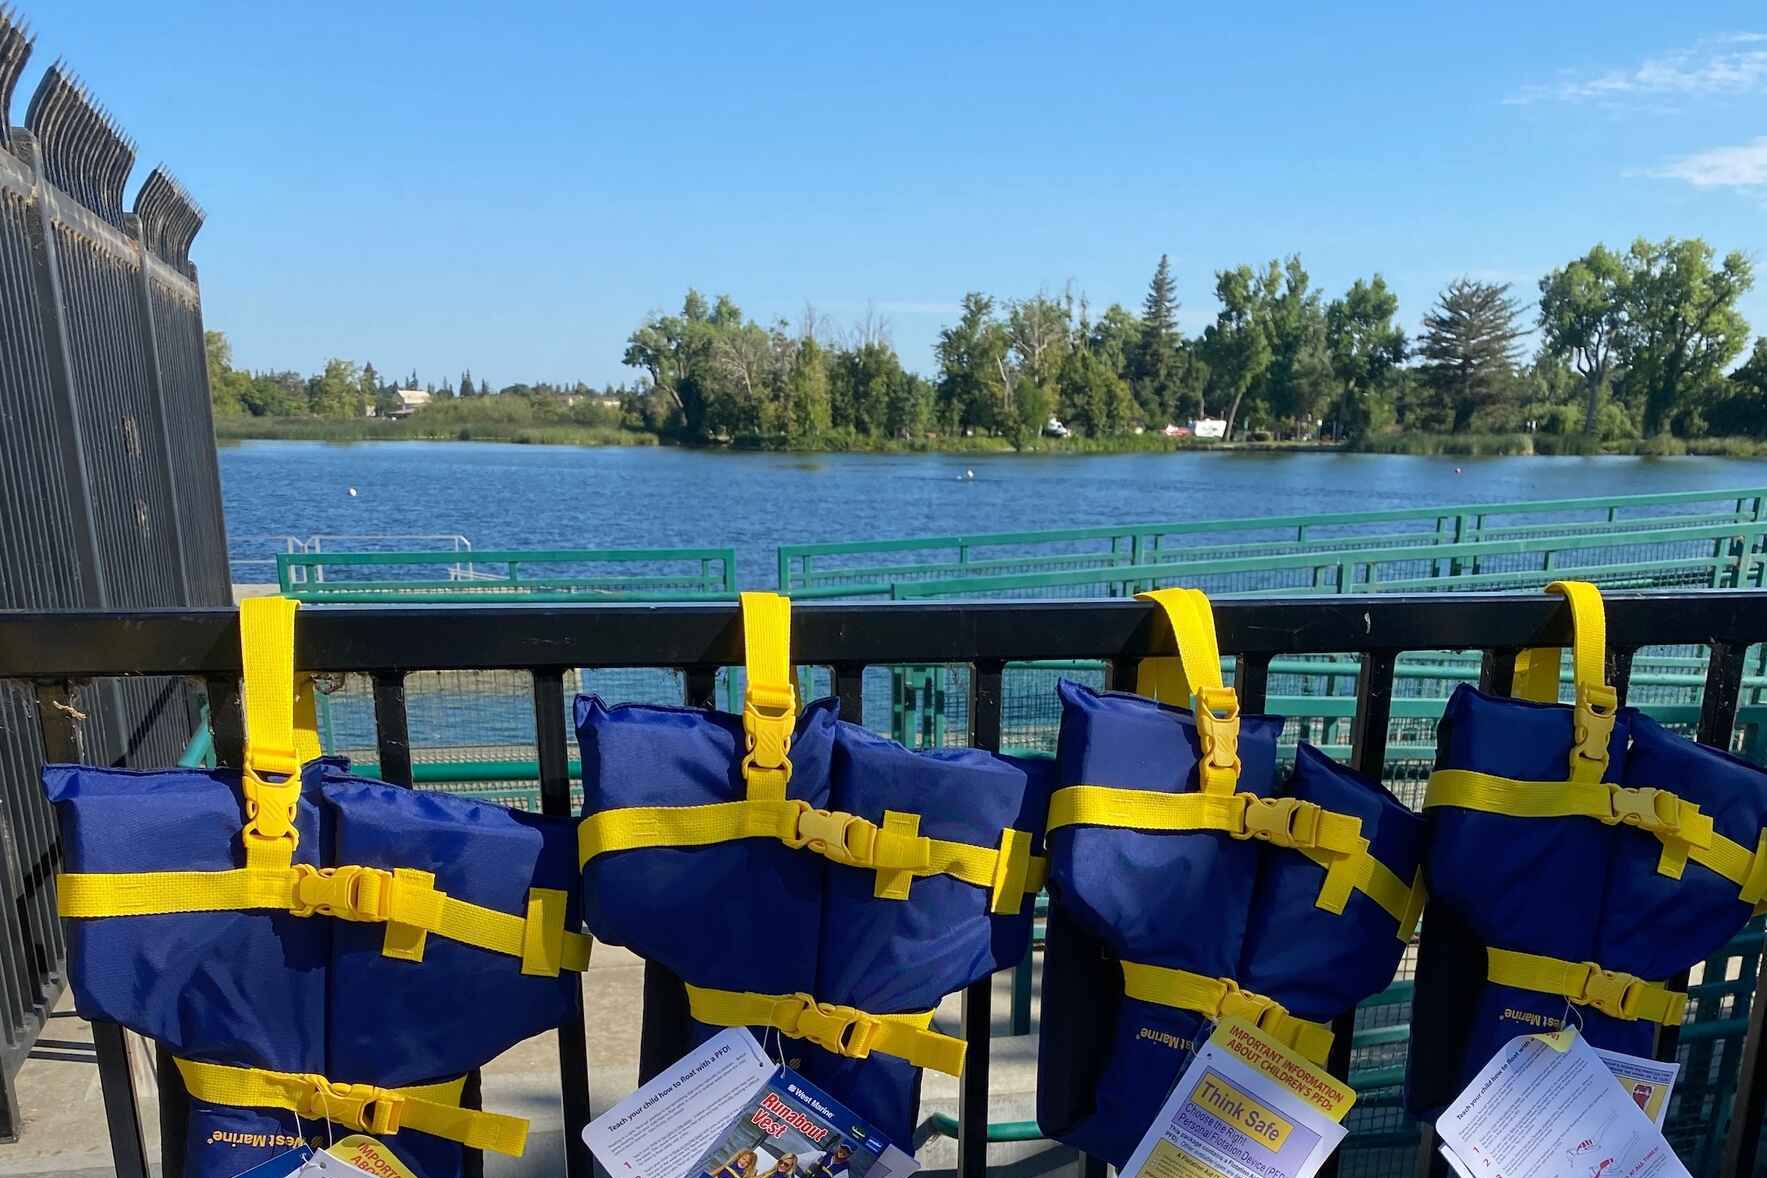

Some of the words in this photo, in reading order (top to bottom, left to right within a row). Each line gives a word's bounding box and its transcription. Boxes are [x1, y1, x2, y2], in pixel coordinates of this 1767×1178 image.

[1226, 1039, 1259, 1068] ABOUT
[1261, 1058, 1312, 1097] CHILDREN'S
[1312, 1090, 1332, 1112] PFDs
[1230, 1025, 1282, 1063] IMPORTANT
[1282, 1056, 1344, 1102] INFORMATION
[608, 1115, 628, 1132] Teach
[628, 1107, 642, 1121] your
[643, 1096, 659, 1111] child
[658, 1088, 673, 1098] how
[673, 1081, 681, 1089] to
[680, 1070, 697, 1084] float
[697, 1060, 710, 1073] with
[752, 1108, 788, 1138] Vest
[760, 1092, 829, 1142] Runabout
[794, 1087, 813, 1104] West
[812, 1099, 834, 1118] Marine
[1202, 1081, 1245, 1121] Think
[1245, 1110, 1279, 1142] Safe
[1179, 1113, 1212, 1139] Personal
[1212, 1130, 1244, 1157] Flotation
[1242, 1150, 1267, 1171] Device
[1185, 1103, 1214, 1126] Choose
[1213, 1118, 1226, 1132] the
[1226, 1125, 1246, 1147] Right
[624, 1161, 632, 1169] 1
